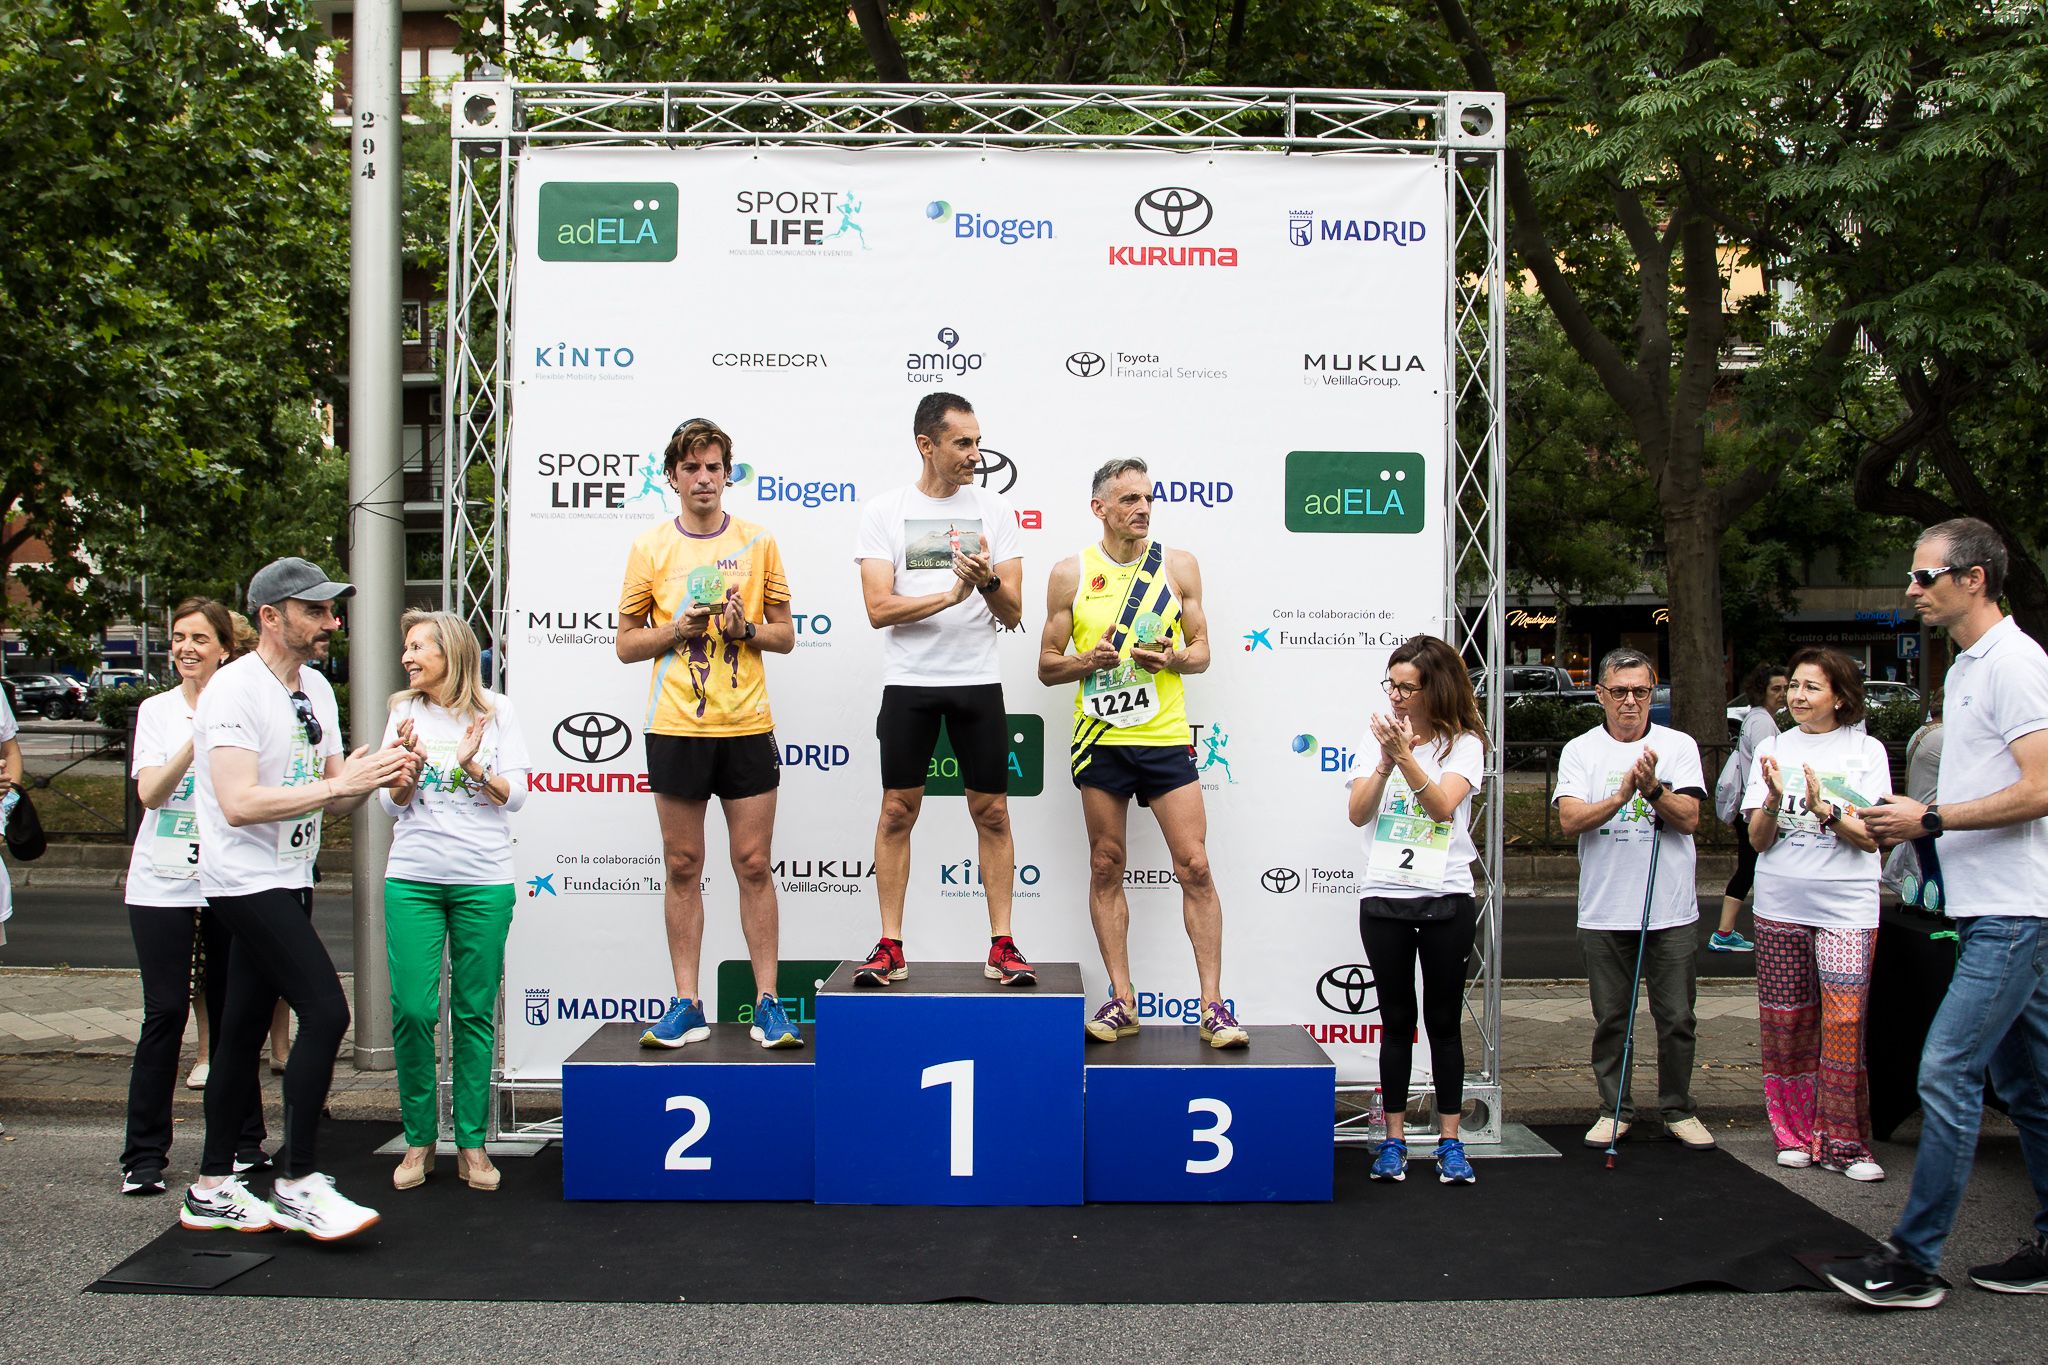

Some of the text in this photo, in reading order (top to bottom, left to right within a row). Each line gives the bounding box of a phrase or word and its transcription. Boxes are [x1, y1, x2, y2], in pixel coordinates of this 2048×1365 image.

[736, 191, 838, 214] SPORT
[557, 218, 658, 244] adELA
[750, 220, 823, 245] LIFE
[955, 213, 1053, 245] Biogen
[1321, 219, 1426, 247] MADRID
[907, 354, 982, 376] amigo
[1117, 352, 1159, 365] Toyota
[1304, 354, 1425, 371] MUKUA
[567, 373, 596, 381] Mobility
[598, 373, 634, 381] Solutions
[907, 372, 943, 382] tours
[1117, 367, 1228, 379] Financial Services
[1303, 375, 1401, 388] by VelillaGroup.
[538, 453, 640, 477] SPORT
[551, 482, 625, 508] LIFE
[757, 475, 856, 508] Biogen
[1152, 481, 1233, 508] ADRID
[1304, 488, 1404, 515] adELA
[1272, 609, 1395, 619] Con la colaboración de:
[1505, 609, 1557, 629] Madrigal
[528, 633, 615, 647] by VelillaGrou
[796, 640, 832, 648] Solutions
[1279, 631, 1355, 645] Fundación
[1788, 632, 1897, 642] Centro de Rehabilitac
[1903, 637, 1917, 655] P
[1092, 688, 1150, 717] 1224
[778, 744, 850, 771] DRID
[556, 854, 661, 864] Con la colaboración
[1399, 848, 1415, 869] 2
[563, 877, 636, 891] Fundación
[1312, 868, 1354, 881] Toyota
[781, 881, 862, 895] VelillaGroup.
[941, 890, 971, 898] Flexible
[1011, 890, 1040, 898] olutions
[1312, 882, 1360, 894] Financia
[557, 998, 665, 1022] MADRID
[920, 1059, 974, 1177] 1
[664, 1095, 712, 1171] 2
[1186, 1098, 1234, 1174] 3
